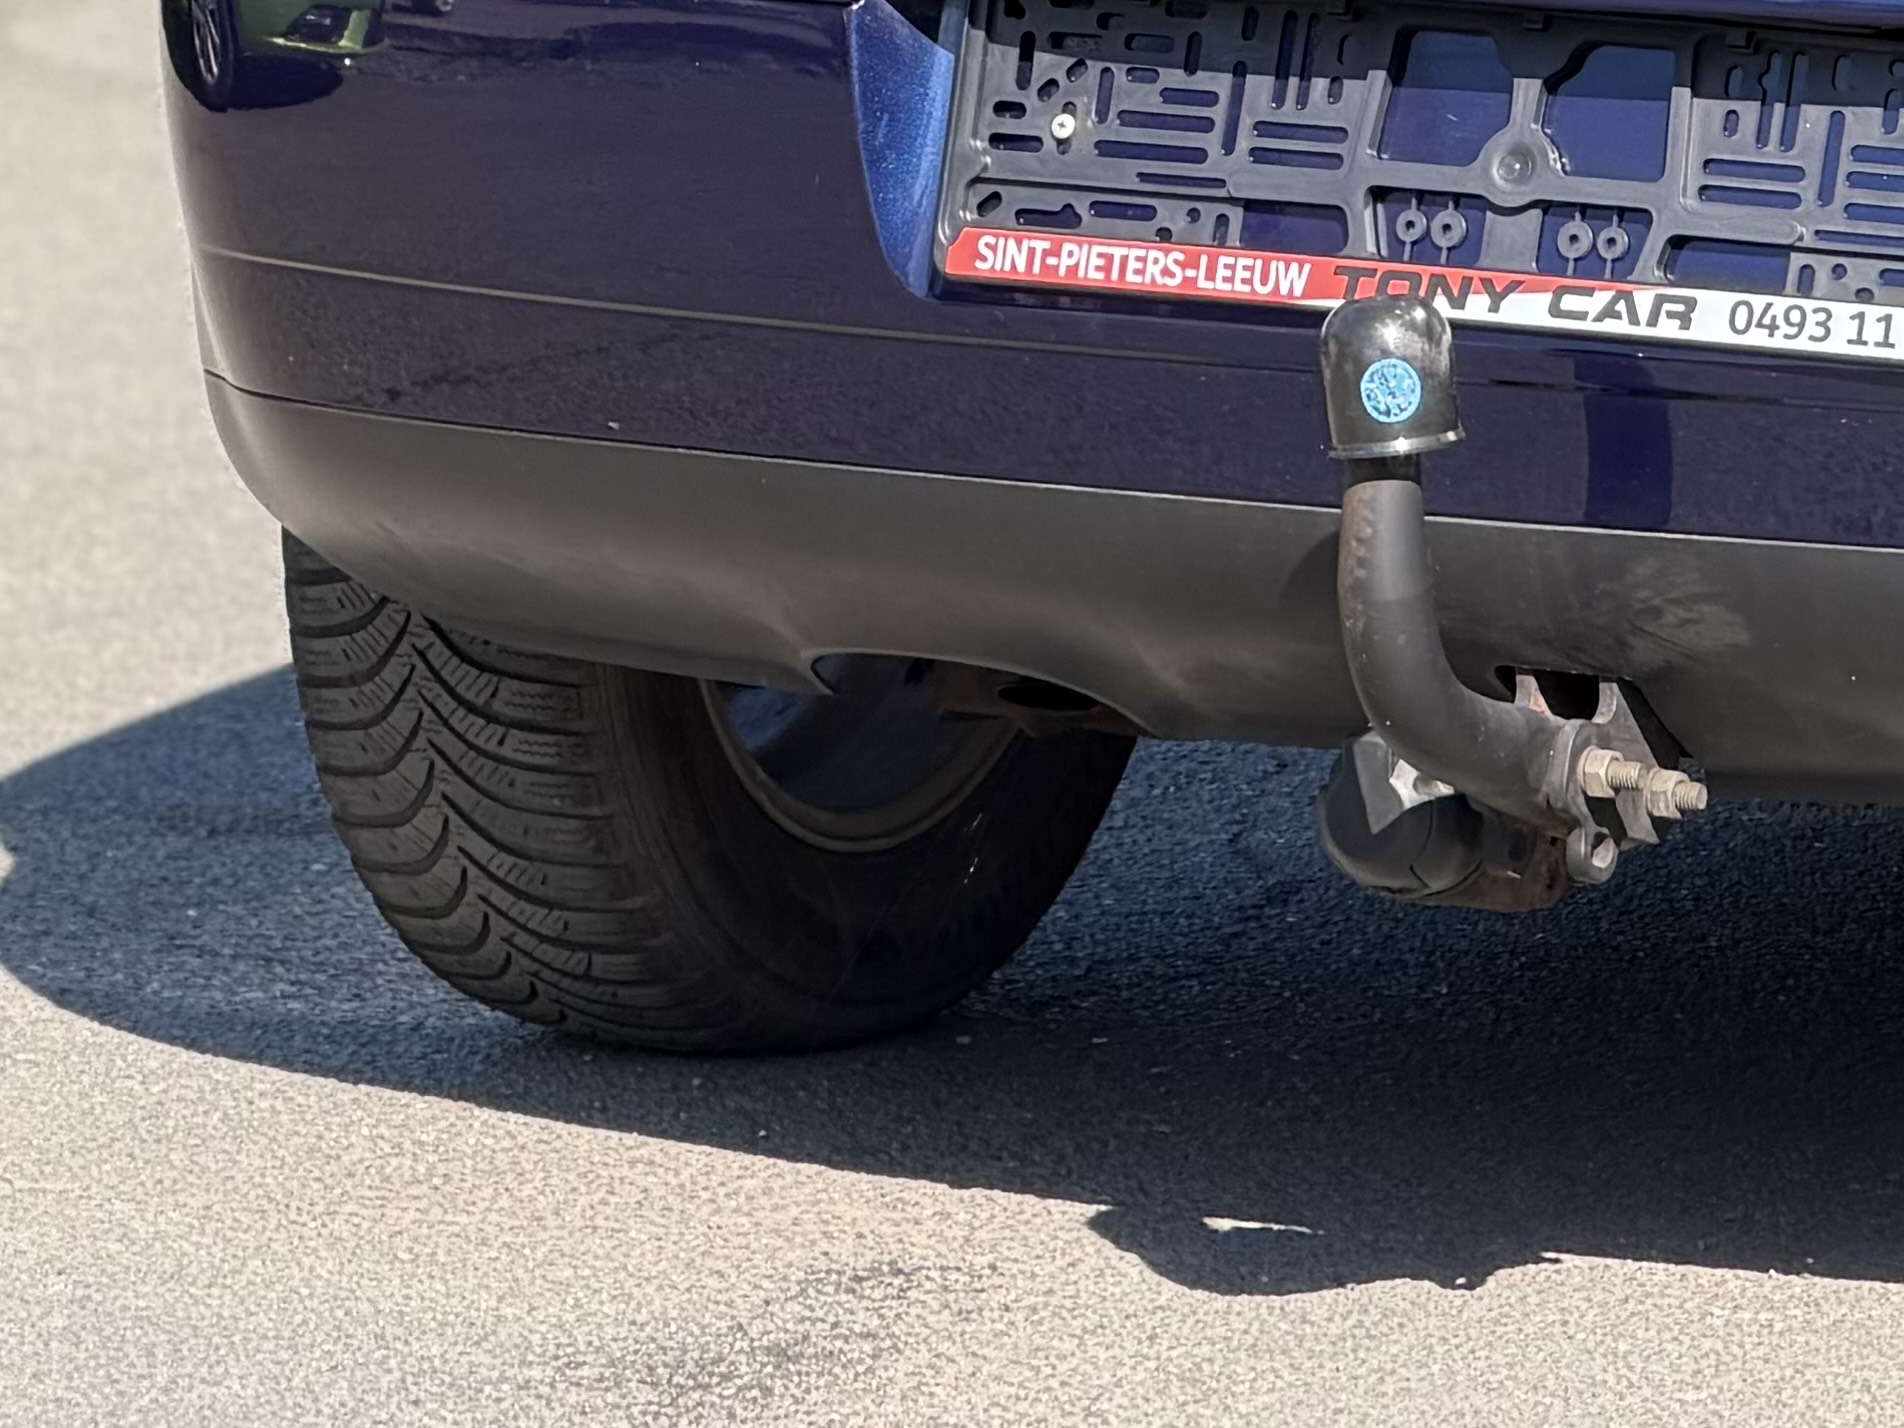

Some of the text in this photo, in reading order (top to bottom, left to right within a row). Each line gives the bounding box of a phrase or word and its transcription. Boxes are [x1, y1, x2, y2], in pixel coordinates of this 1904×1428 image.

[974, 234, 1312, 297] SINT-PIETERS-LEEUW
[1547, 285, 1698, 331] CAR
[1728, 299, 1832, 343] 0493
[1846, 311, 1896, 350] 11
